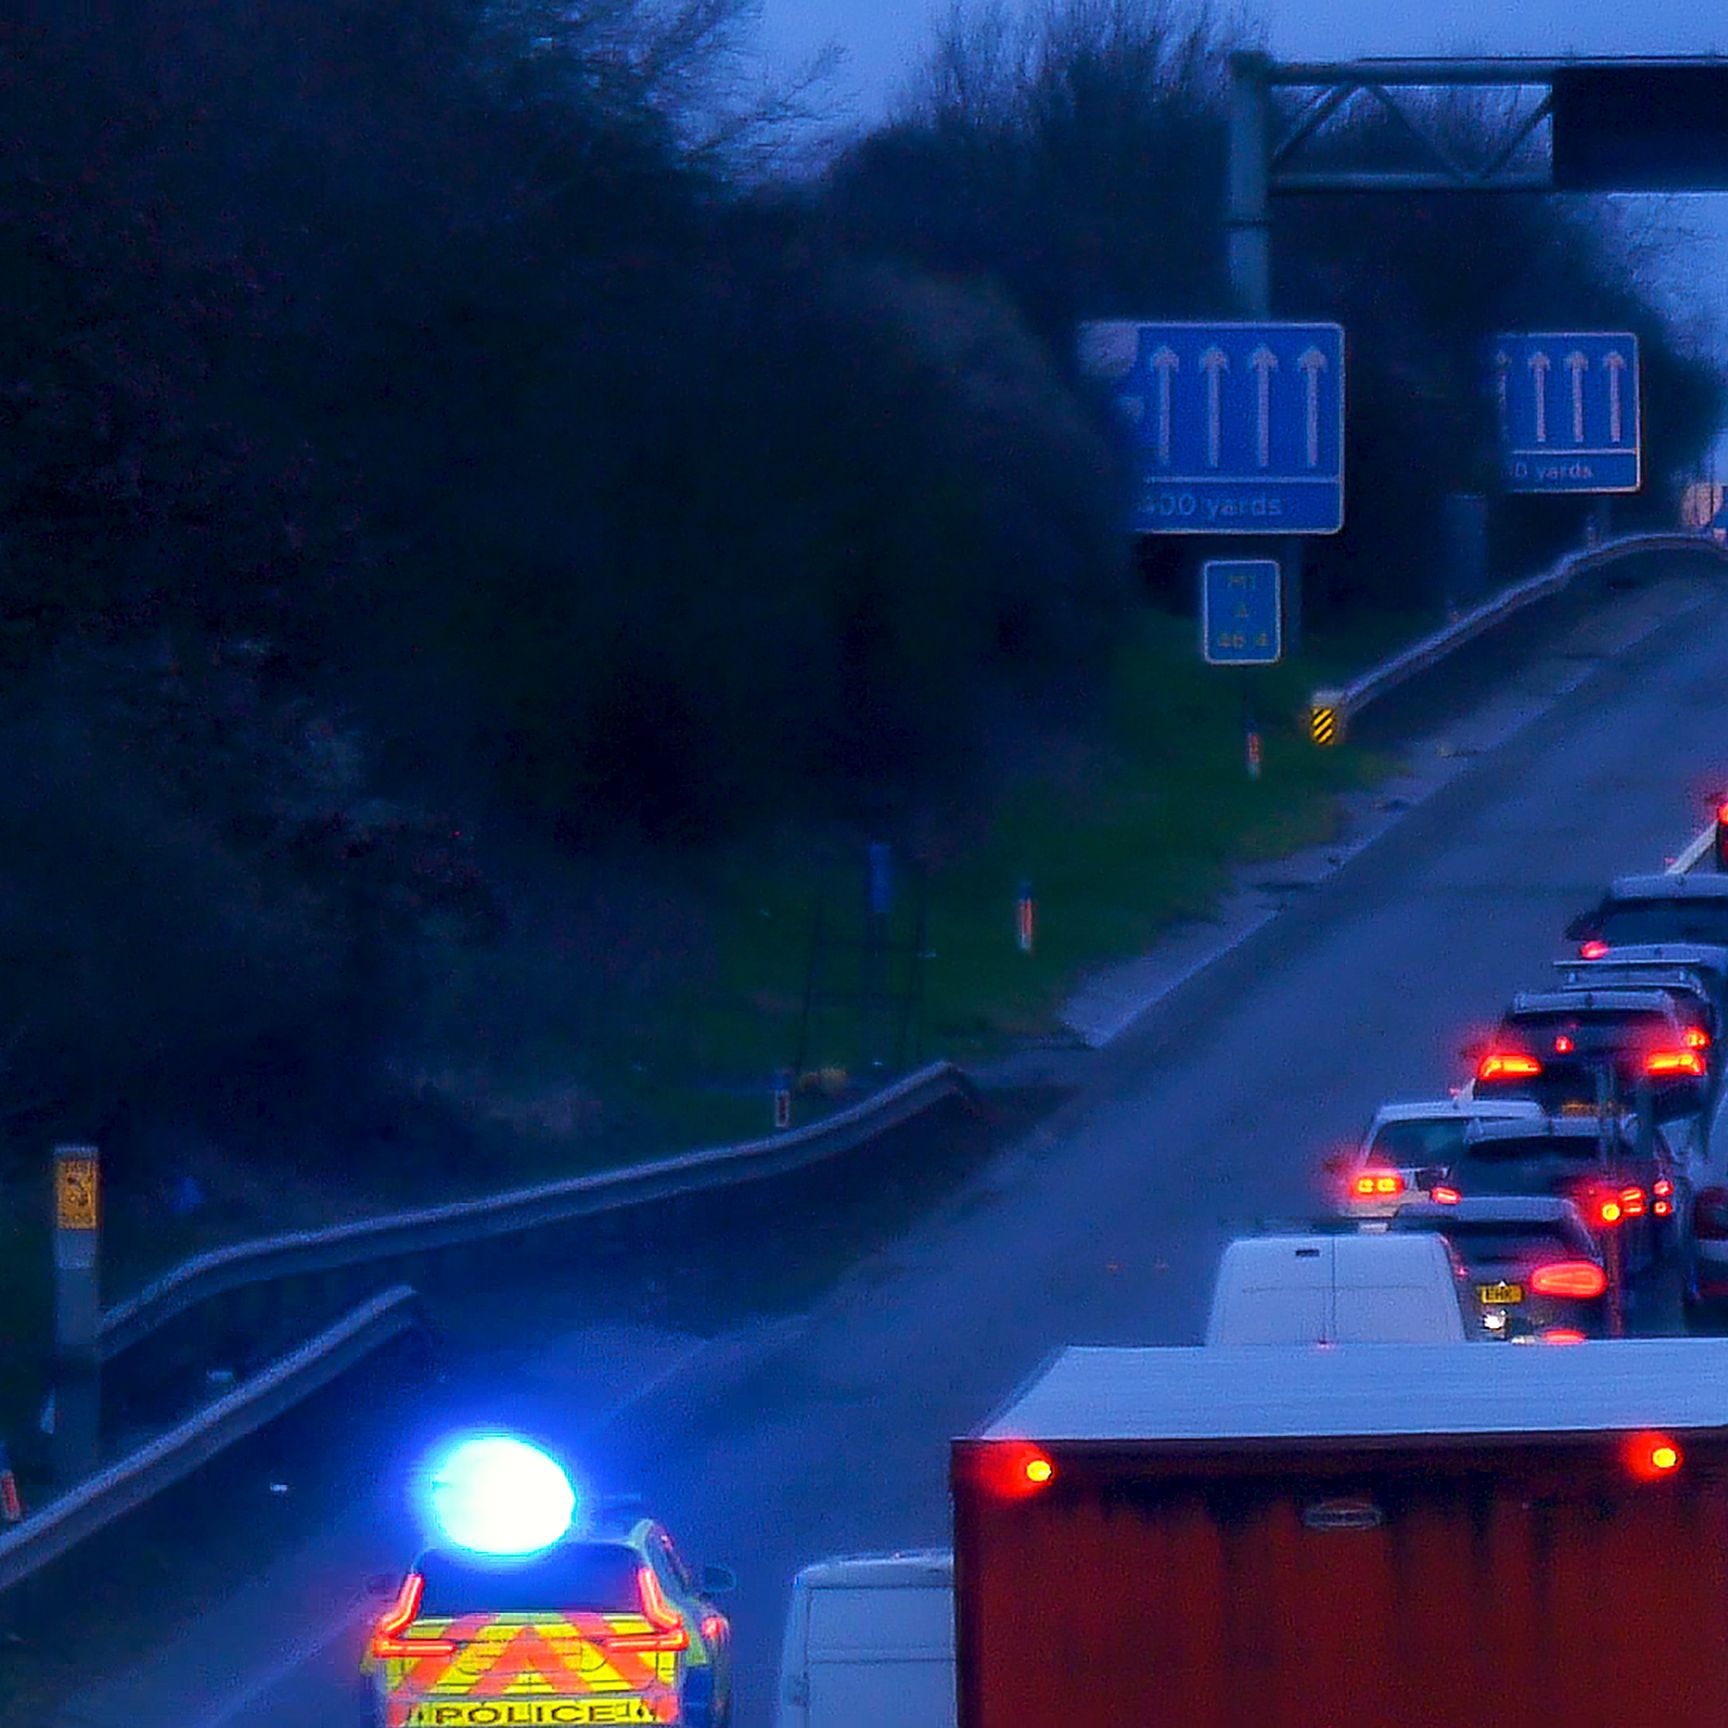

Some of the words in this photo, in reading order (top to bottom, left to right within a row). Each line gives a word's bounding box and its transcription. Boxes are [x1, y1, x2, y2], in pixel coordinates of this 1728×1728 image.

[1534, 460, 1595, 483] yards
[1201, 491, 1283, 521] yards
[435, 1704, 617, 1725] POLICE
